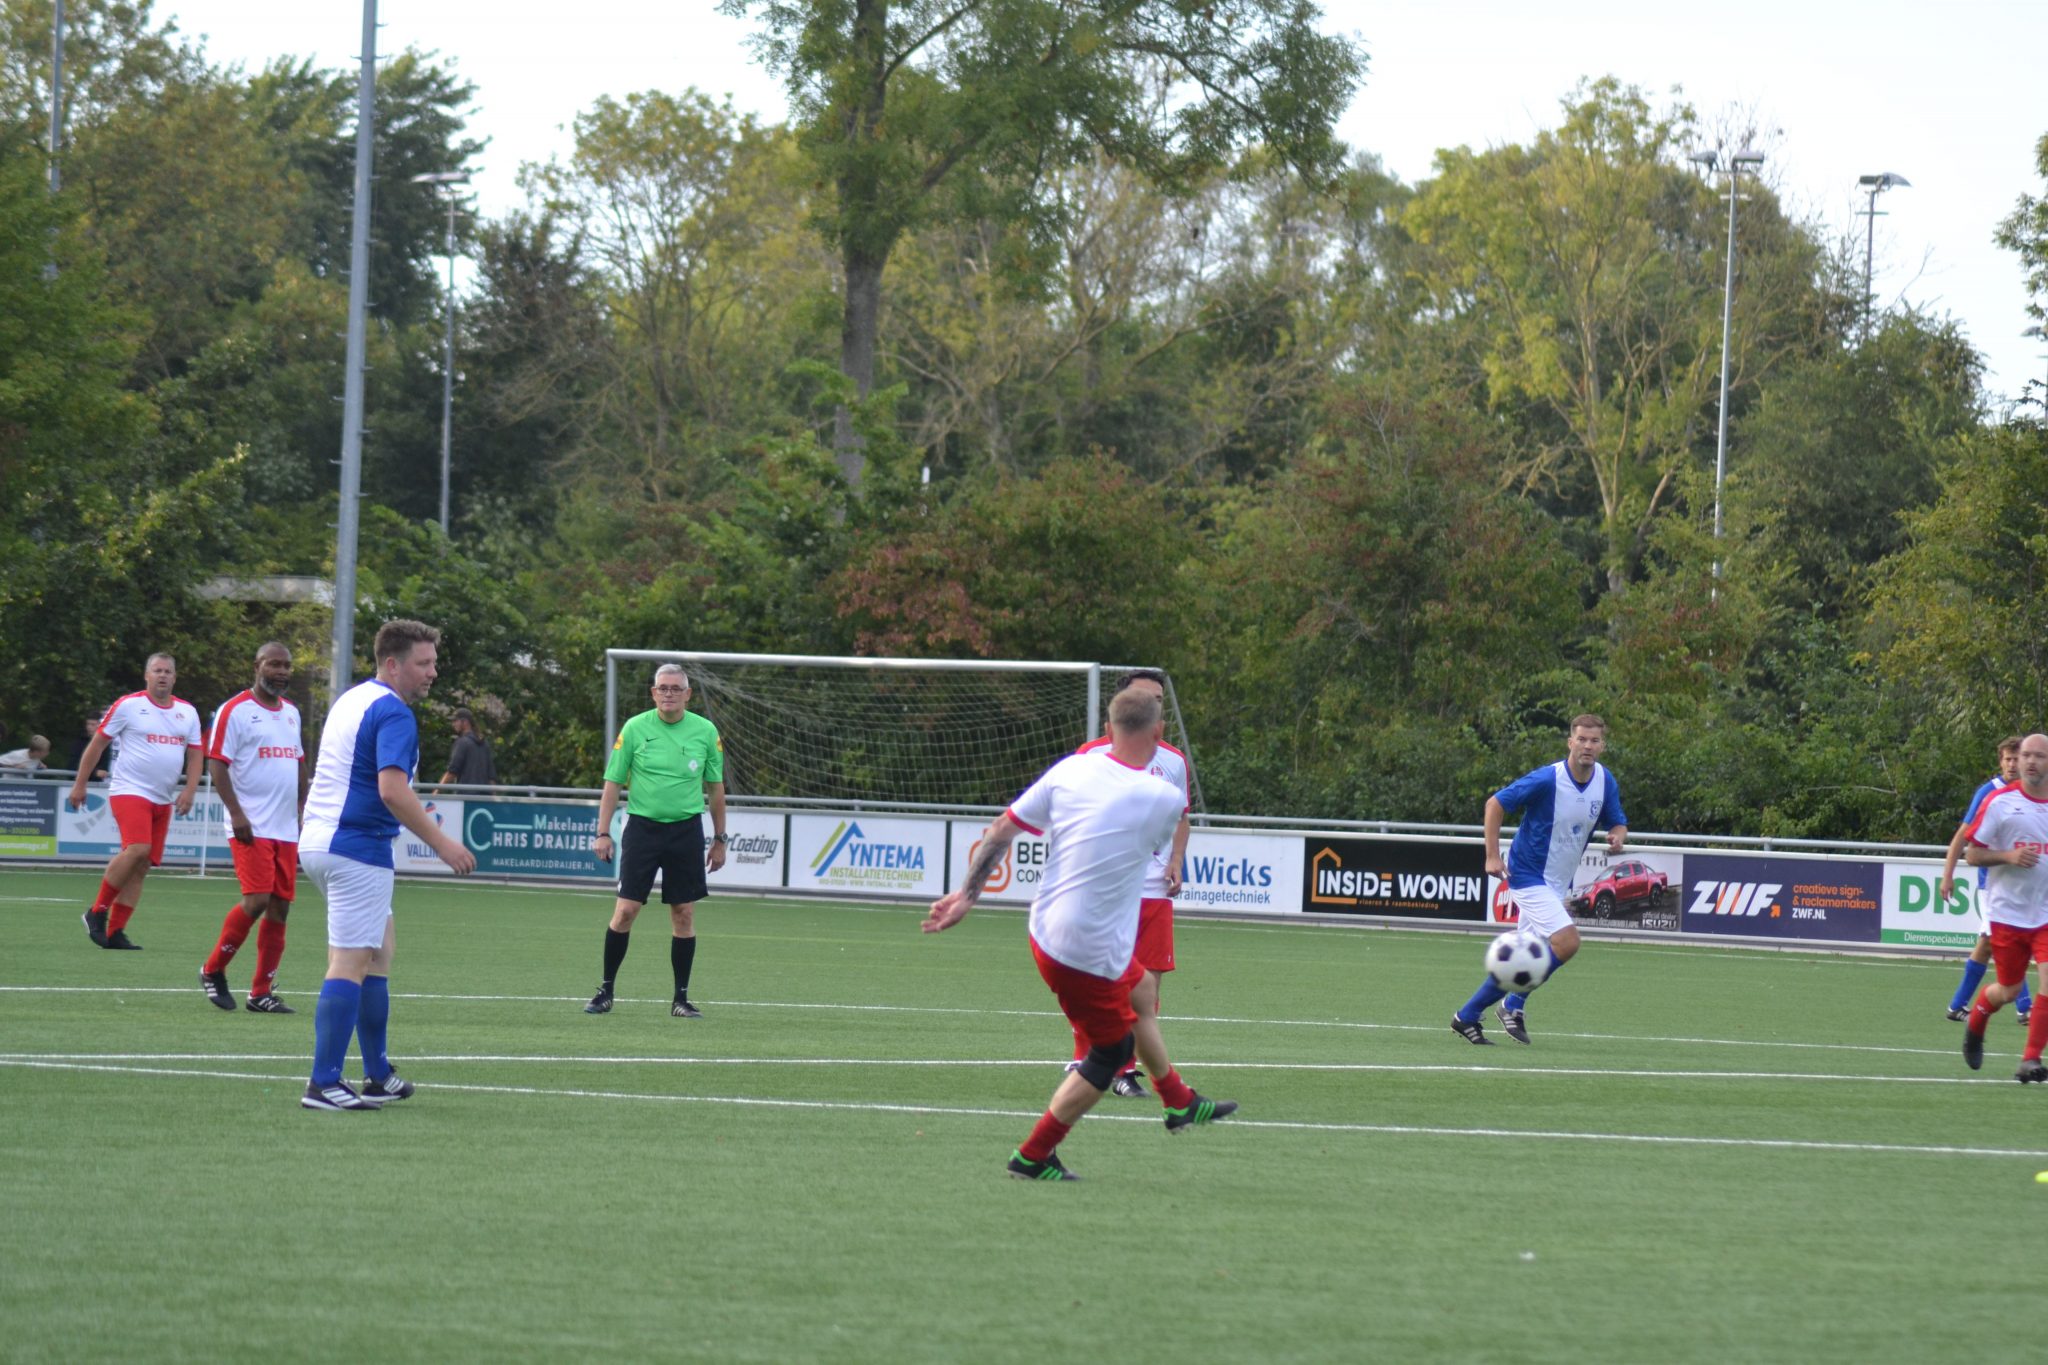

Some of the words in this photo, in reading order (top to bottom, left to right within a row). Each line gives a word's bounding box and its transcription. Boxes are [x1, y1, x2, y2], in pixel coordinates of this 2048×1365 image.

[849, 843, 925, 869] YNTEMA
[491, 857, 596, 871] MAKELAARDIJDRAIJER.NL
[1193, 855, 1272, 887] Wicks
[829, 867, 924, 881] INSTALLATIETECHNIEK
[1016, 869, 1043, 883] CON
[1318, 869, 1393, 898] INSIDE
[1398, 873, 1481, 902] WONEN
[1793, 884, 1838, 894] creatieve
[1792, 895, 1799, 907] &
[1802, 896, 1877, 910] reclamemakers
[1792, 908, 1827, 920] ZWF.NL
[1642, 919, 1677, 930] ISUZU
[1904, 931, 1975, 945] Dierenspeciaalzaak
